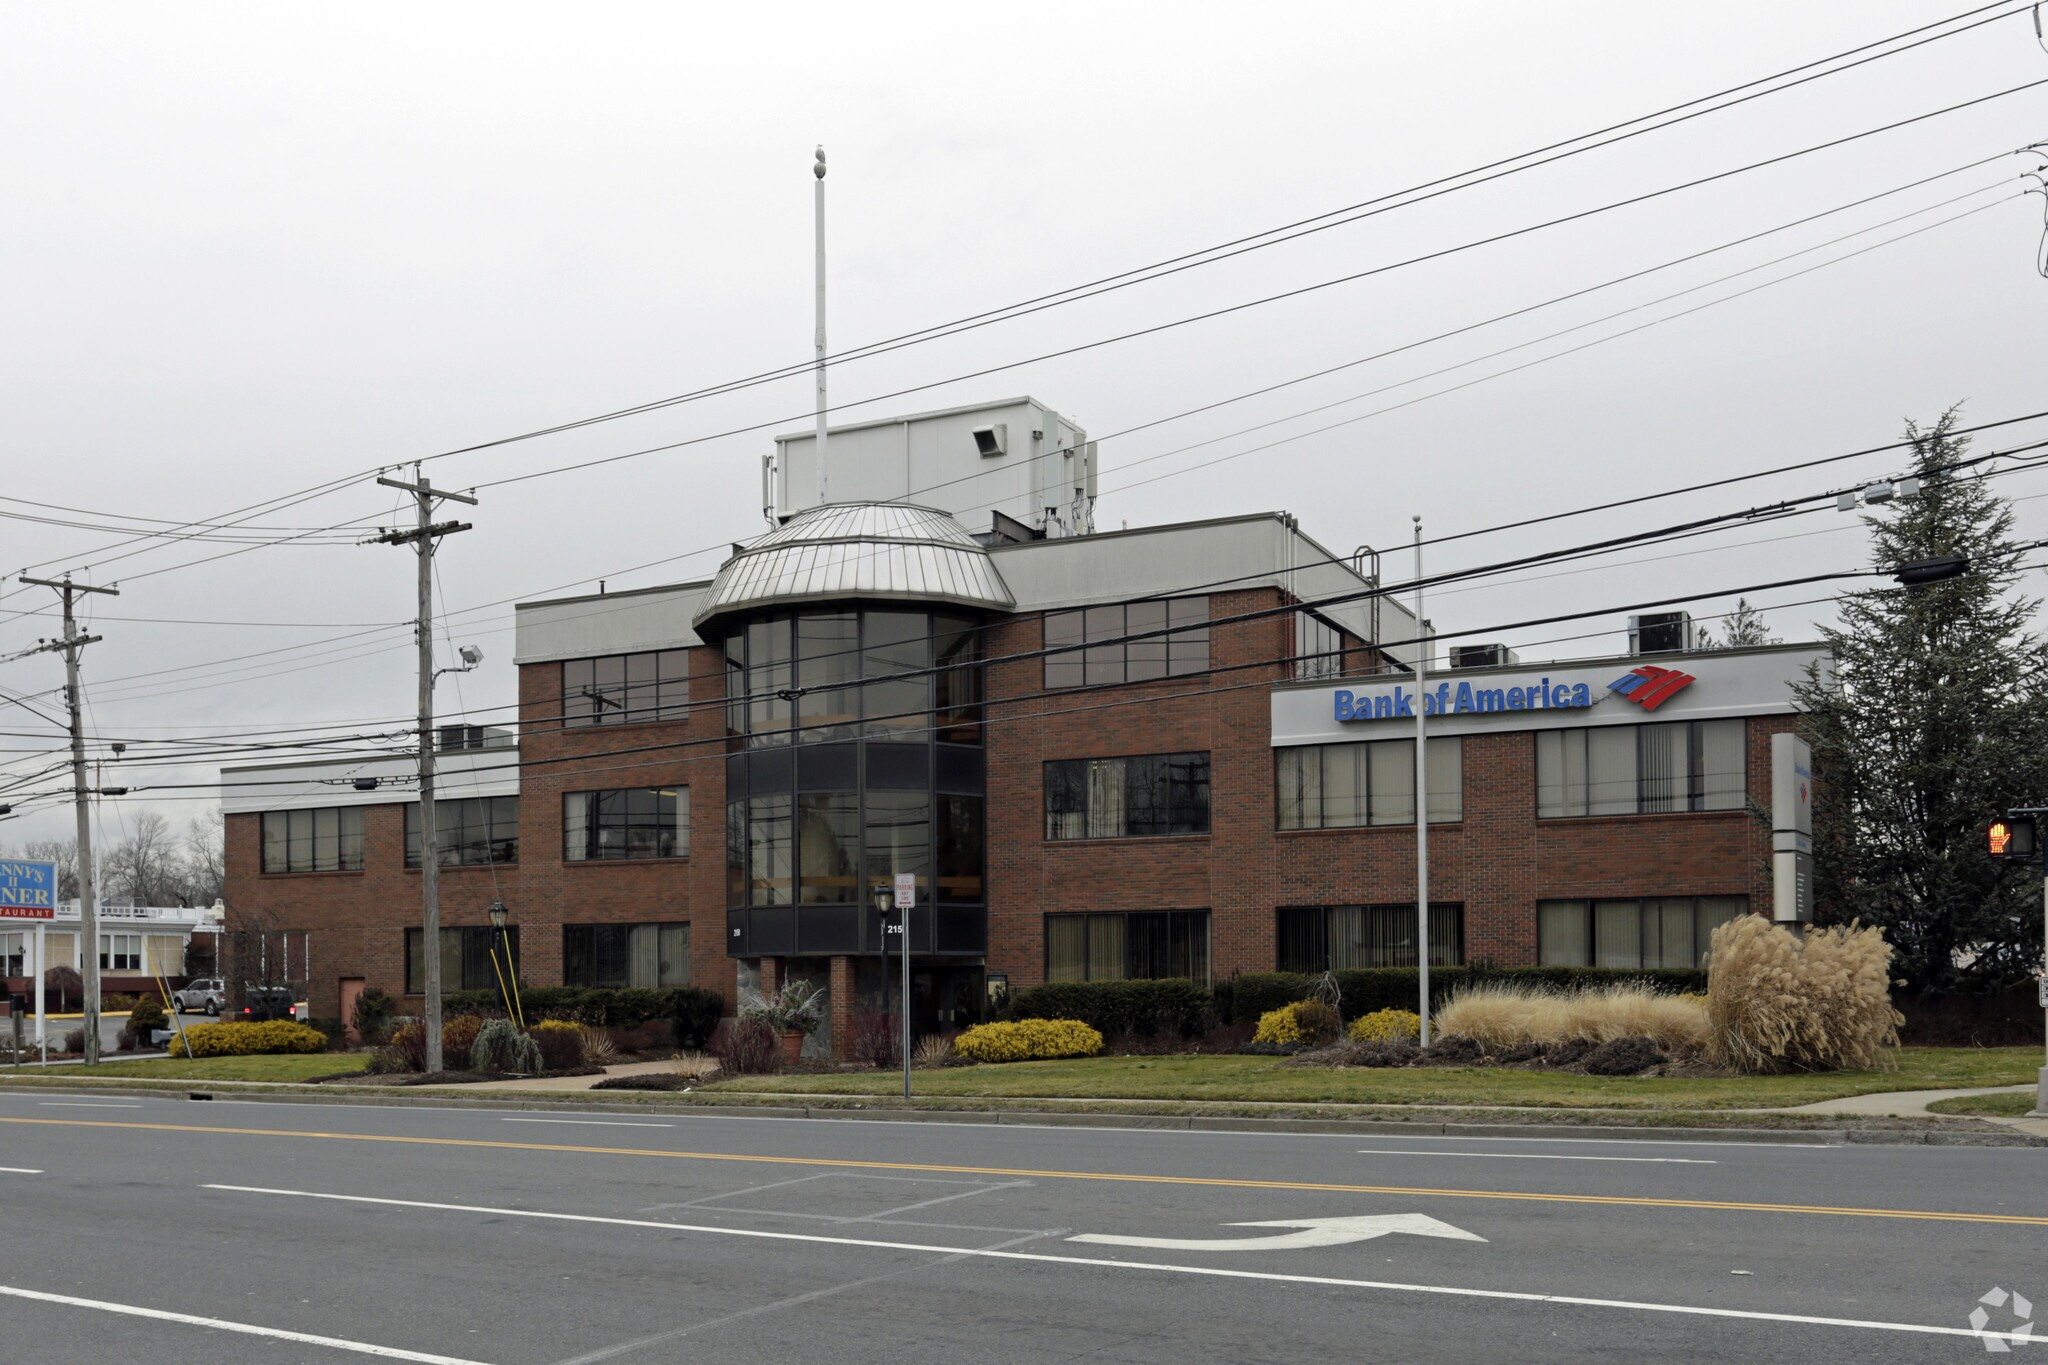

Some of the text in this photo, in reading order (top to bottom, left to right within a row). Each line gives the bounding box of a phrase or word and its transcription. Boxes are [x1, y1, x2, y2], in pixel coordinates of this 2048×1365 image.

[1334, 677, 1591, 721] Bank of America
[0, 863, 45, 884] NNY'S
[887, 925, 903, 934] 215
